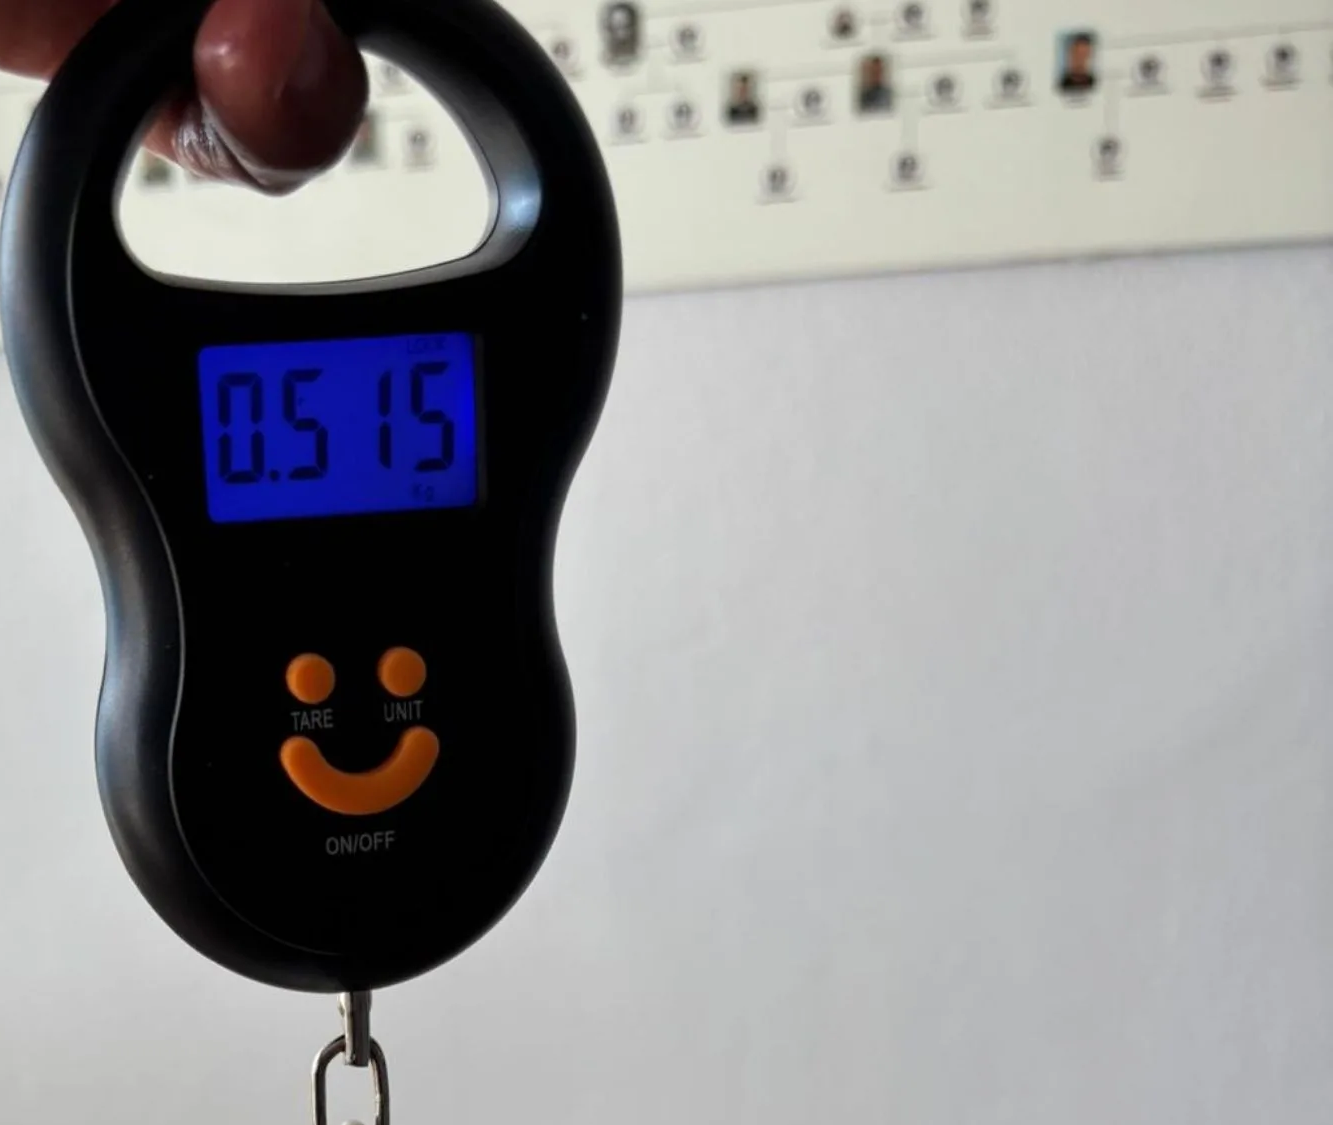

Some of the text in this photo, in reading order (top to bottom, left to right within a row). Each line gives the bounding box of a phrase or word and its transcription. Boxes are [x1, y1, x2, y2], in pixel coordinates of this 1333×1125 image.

[217, 360, 455, 484] 0.515
[290, 700, 424, 732] TARE UNIT
[325, 830, 396, 856] ON/OFF
